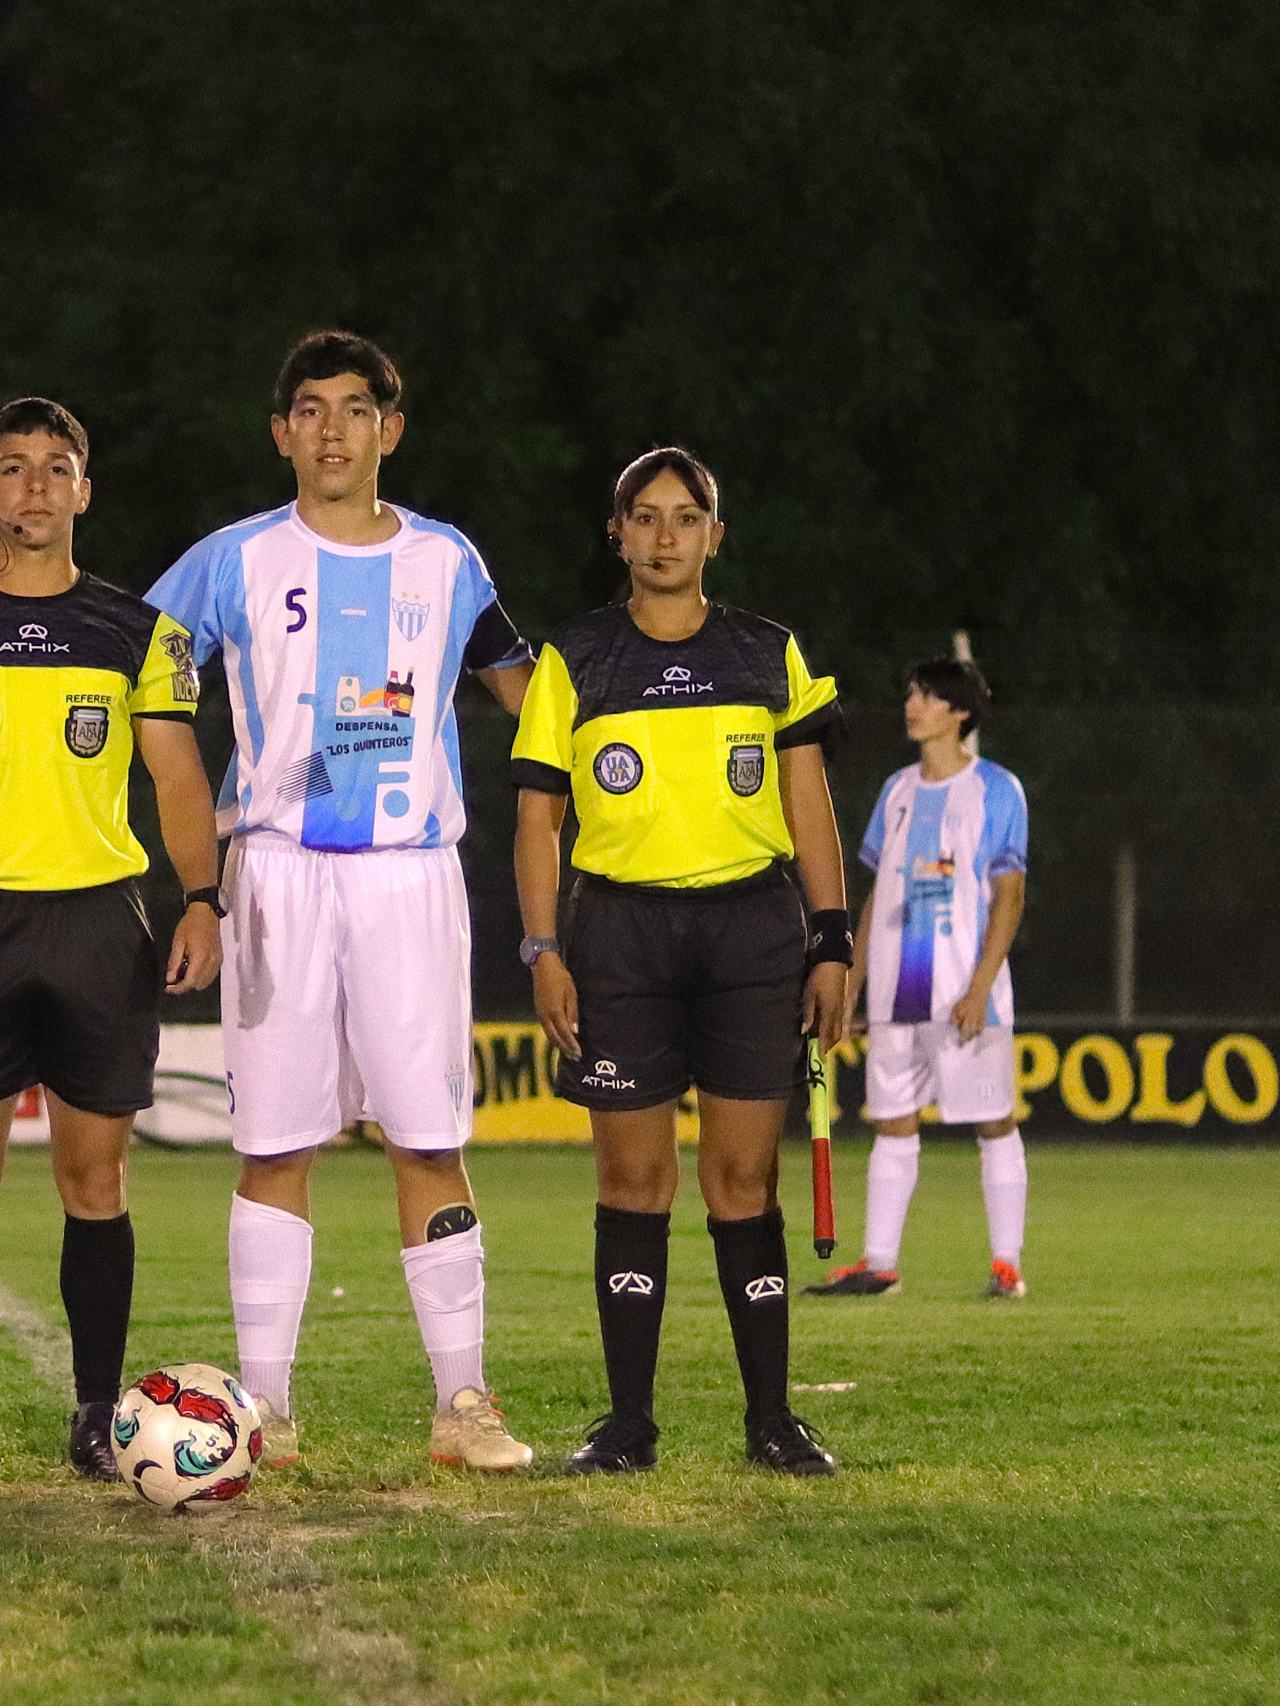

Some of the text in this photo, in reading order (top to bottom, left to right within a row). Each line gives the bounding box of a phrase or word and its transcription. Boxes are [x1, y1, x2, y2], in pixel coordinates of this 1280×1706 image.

[285, 587, 307, 633] 5
[0, 642, 70, 653] ATHIX
[642, 681, 714, 697] ATHIX
[65, 694, 112, 705] REFEREE
[335, 721, 399, 732] DESPENSA
[581, 1074, 636, 1090] ATHIX
[1006, 1031, 1279, 1127] POLO
[205, 1433, 220, 1448] 5
